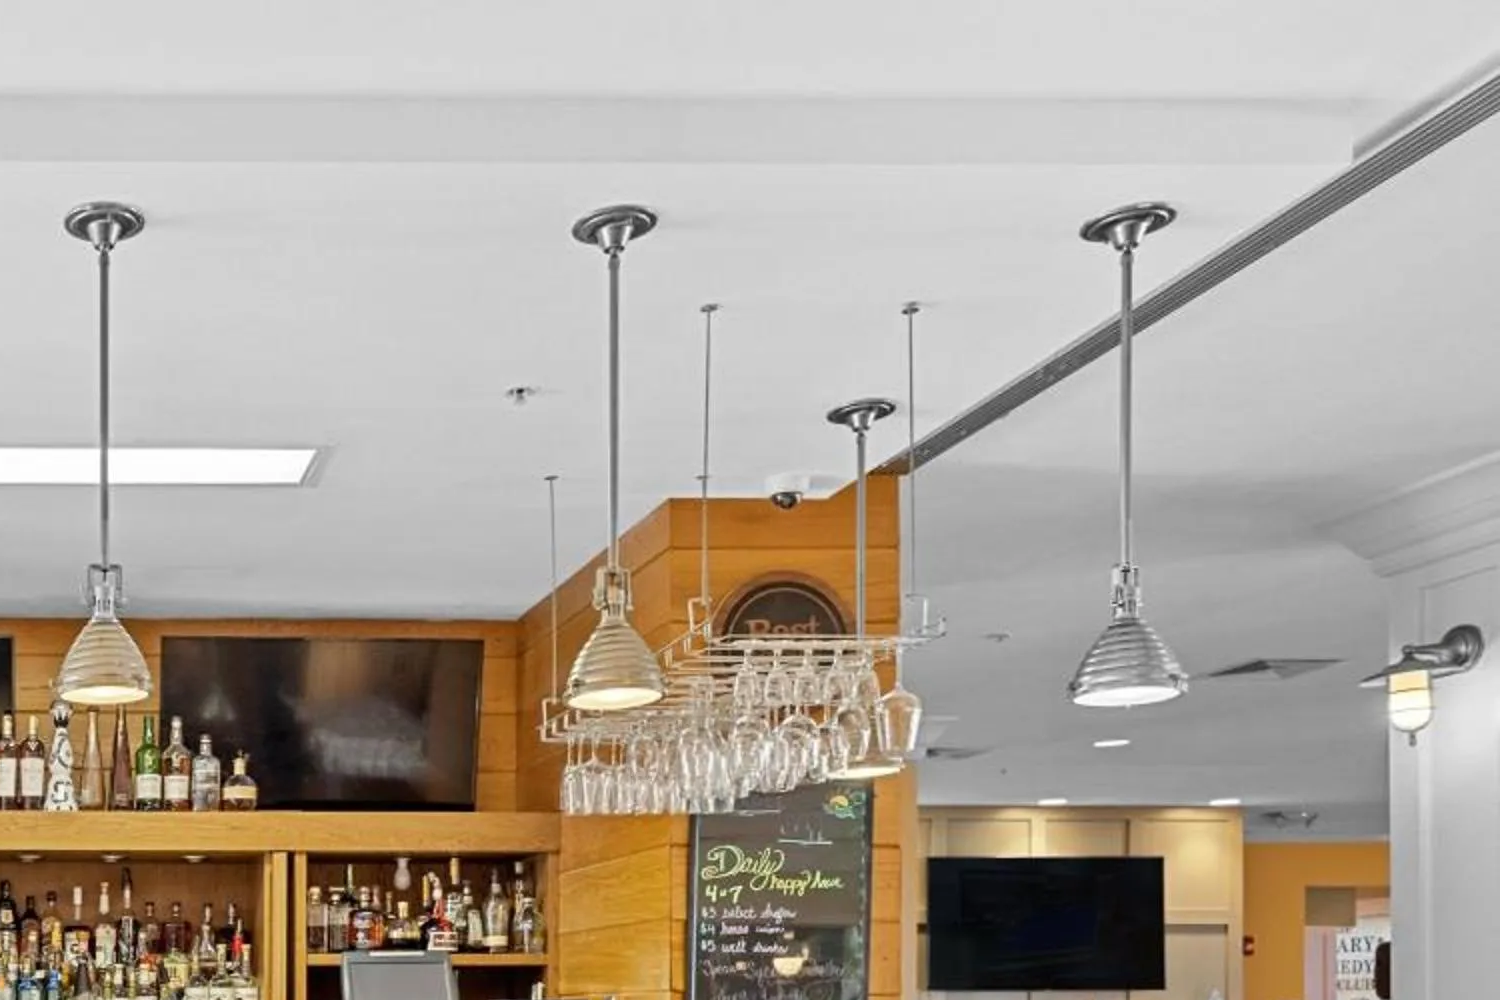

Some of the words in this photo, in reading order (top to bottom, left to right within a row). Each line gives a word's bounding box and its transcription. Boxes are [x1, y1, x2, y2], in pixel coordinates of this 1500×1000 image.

[701, 845, 785, 891] Daily
[705, 884, 744, 904] 4-7
[768, 869, 812, 897] happy
